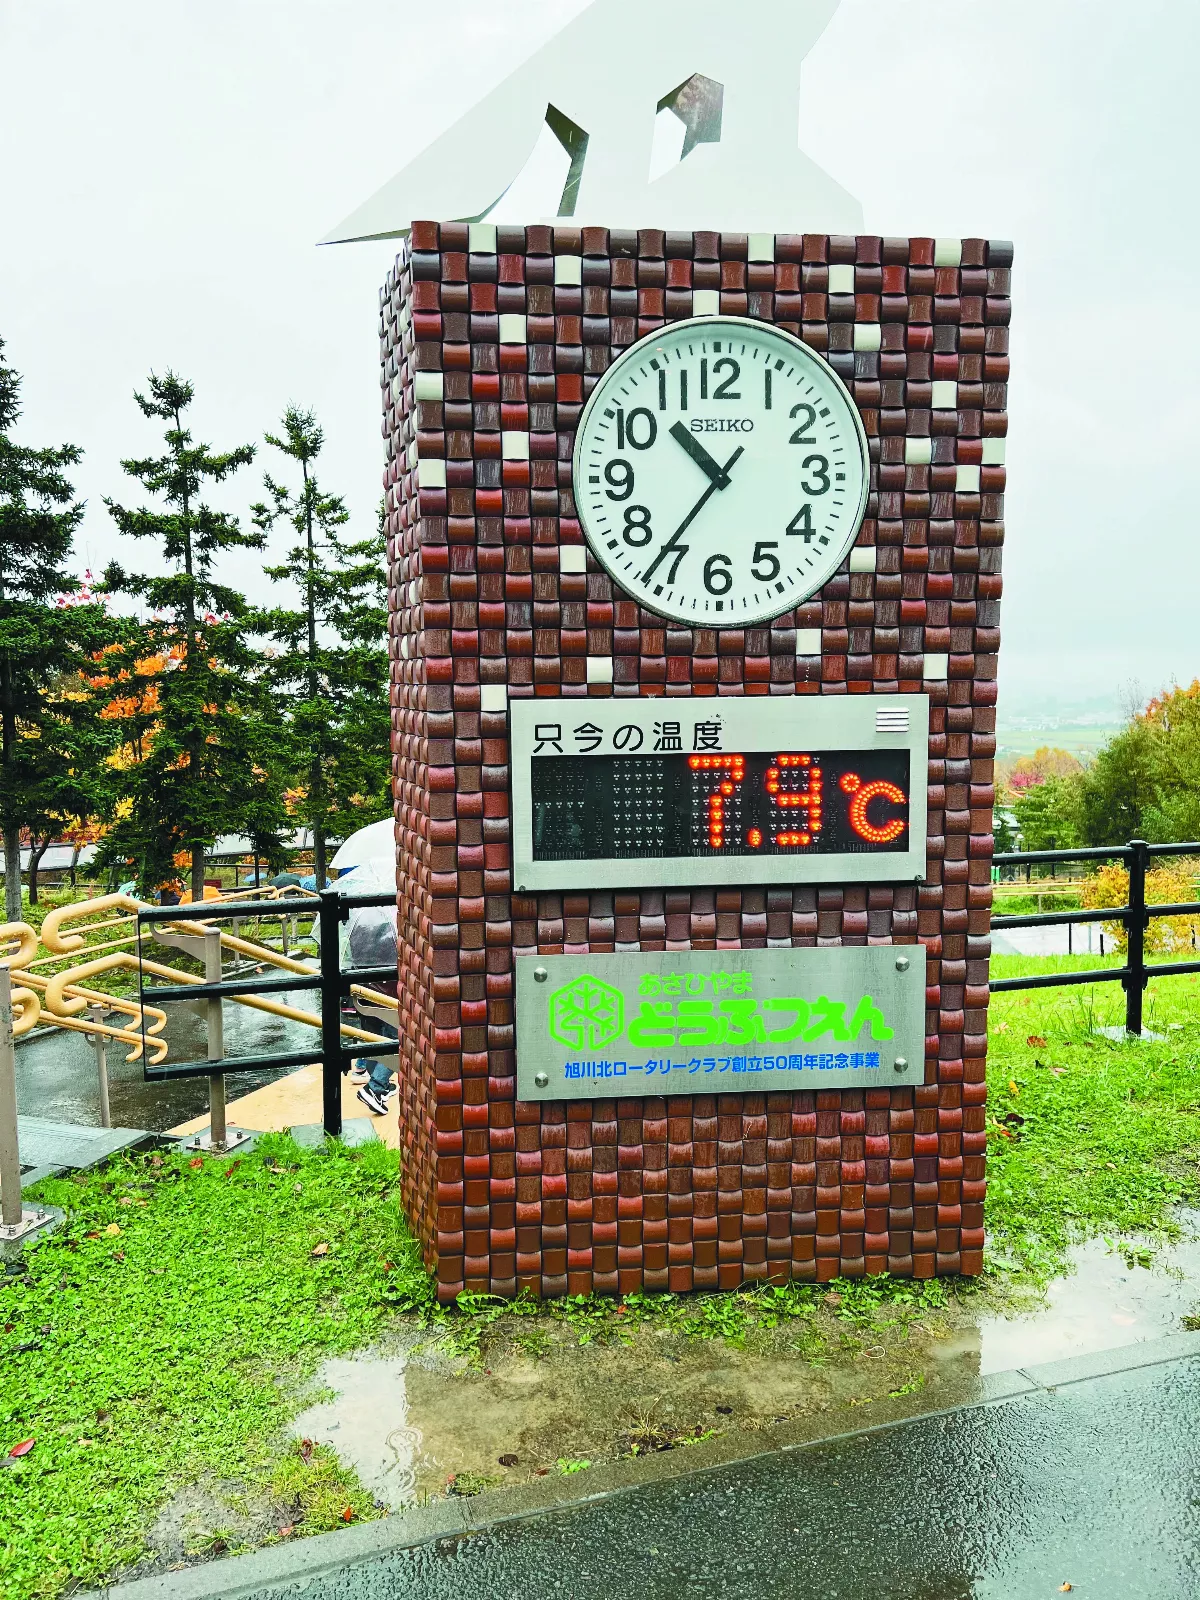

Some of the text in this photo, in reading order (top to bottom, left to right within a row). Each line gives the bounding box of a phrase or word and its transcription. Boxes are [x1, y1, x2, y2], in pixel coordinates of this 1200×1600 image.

[659, 369, 687, 410] 11
[700, 357, 741, 400] 12
[765, 369, 772, 410] 1
[617, 407, 657, 450] 10
[690, 418, 754, 432] SEIKO
[789, 403, 817, 444] 2
[604, 459, 635, 501] 9
[800, 454, 831, 496] 3
[622, 505, 652, 547] 8
[785, 503, 817, 544] 4
[661, 545, 690, 584] 7
[703, 553, 733, 596] 6
[750, 541, 780, 581] 5
[533, 720, 723, 754] 只今の温度
[638, 970, 753, 997] あさひやま
[628, 994, 894, 1048] どうぶつえん
[564, 1052, 880, 1079] 旭川北ロータリークラブ創立50周年記念事業
